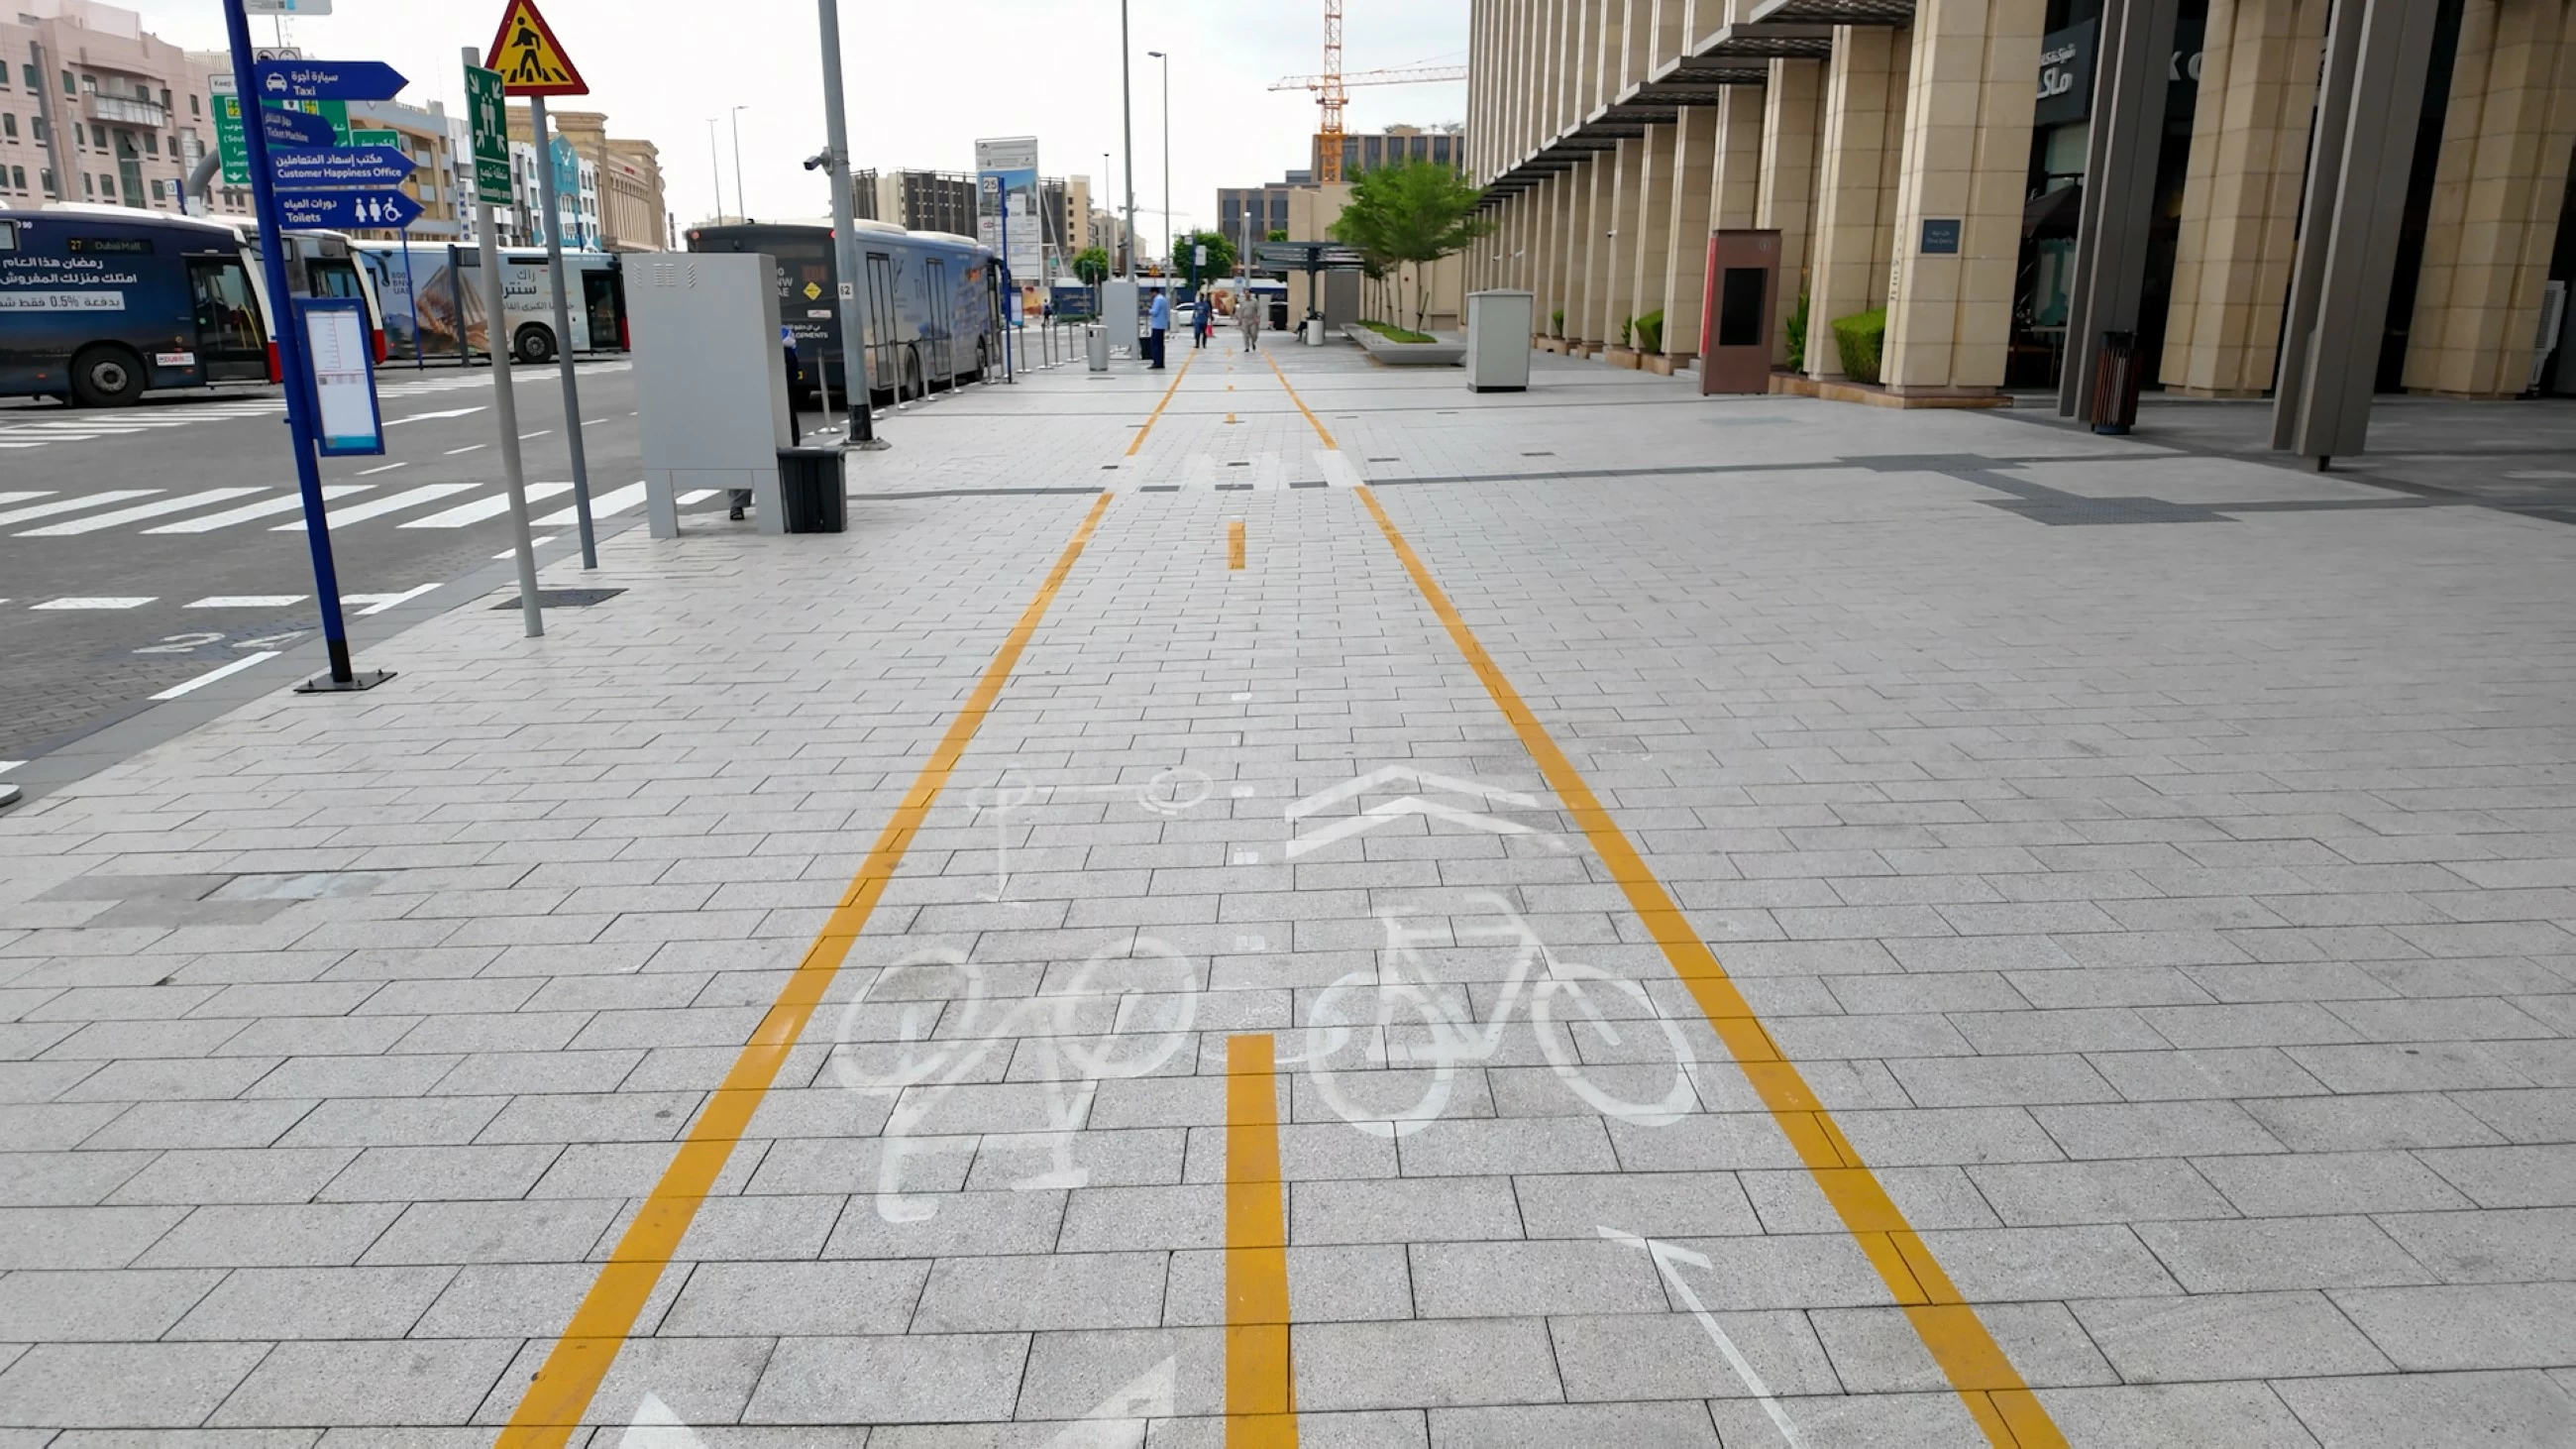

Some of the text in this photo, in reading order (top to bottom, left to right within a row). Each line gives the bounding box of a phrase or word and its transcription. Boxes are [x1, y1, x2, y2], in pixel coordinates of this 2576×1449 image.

[290, 69, 339, 83] سيارة أجرة
[293, 86, 316, 96] Taxi
[266, 126, 310, 144] Ticket Machine
[275, 154, 383, 167] مكتب إسعاد المتعاملين
[277, 167, 402, 180] Customer Happiness Office
[984, 179, 997, 189] 25
[283, 198, 338, 209] دورات المياه
[285, 212, 322, 223] Toilets
[70, 240, 142, 252] 27 Dubai Mall
[3, 257, 103, 270] رمضان هذا العام
[0, 272, 138, 285] امتلك منزلك المفروش
[19, 296, 46, 308] فقط
[50, 294, 79, 308] 0.5%
